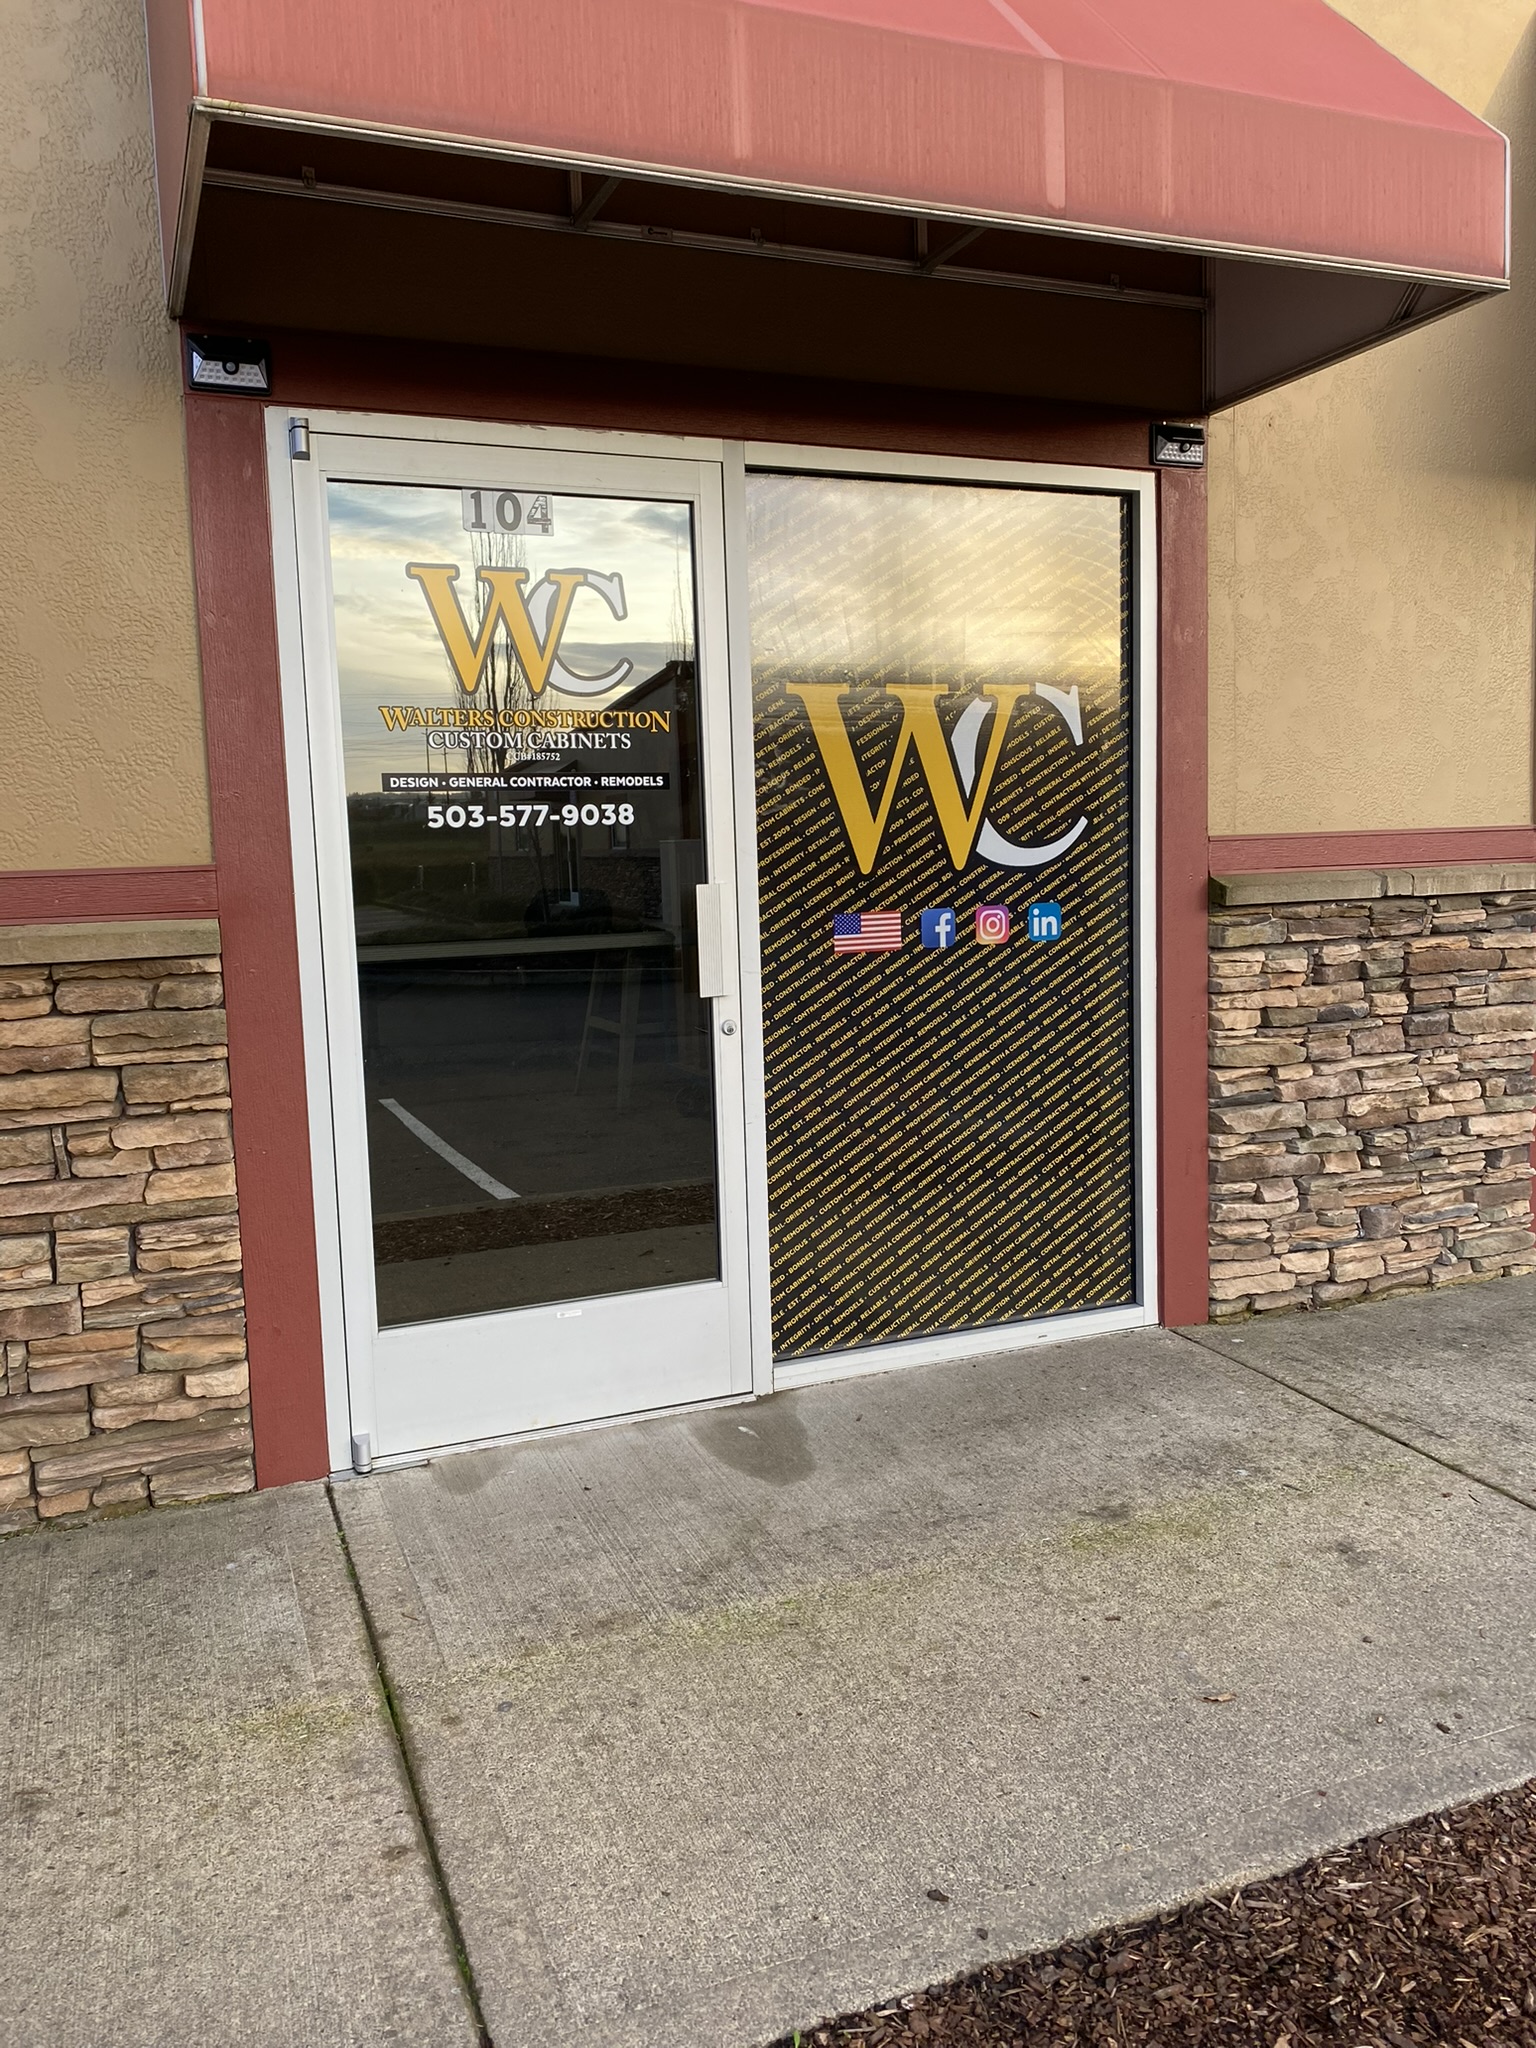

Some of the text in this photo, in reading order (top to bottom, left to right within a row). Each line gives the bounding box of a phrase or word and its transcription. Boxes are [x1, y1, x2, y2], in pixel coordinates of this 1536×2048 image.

[469, 490, 552, 534] 104
[379, 706, 671, 732] WALTERS CONSTRUCTION
[428, 731, 631, 749] CUSTOM CABINETS
[505, 752, 561, 761] CCB#185752
[766, 742, 802, 769] REMODELS
[856, 707, 881, 727] DESIGN
[389, 776, 664, 788] DESIGN GENERAL CONTRACTOR REMODELS
[427, 803, 635, 828] 503-577-9038
[772, 824, 791, 840] 2009
[792, 806, 817, 826] DESIGN
[773, 795, 805, 820] CABINETS
[783, 772, 812, 795] BONDED
[802, 724, 1061, 909] LICENSED CONSCIOUS RELIABLE
[762, 753, 1045, 956] REMODELS CUSTOM CABINETS BONDED
[771, 850, 805, 877] INTEGRITY
[775, 860, 817, 892] CONTRACTOR
[776, 749, 1099, 982] INSURED DESIGN GENERAL CONTRACTOR
[778, 753, 1069, 962] RELIABLE GENERAL CONTRACTOR CABINETS CONSTRUCTION
[805, 799, 929, 890] CONSCIOUS DESIGN
[772, 772, 1113, 1020] DESIGN GENERAL CONTRACTOR CABINETS DETAIL-ORIENTED LICENSED
[766, 1088, 797, 1114] LICENSED
[798, 1067, 826, 1090] BONDED
[827, 1045, 855, 1069] INSURED
[856, 1011, 901, 1047] PROFESSIONAL
[902, 979, 945, 1013] CONTRACTORS
[943, 967, 960, 983] WITH
[1055, 881, 1078, 900] DESIGN
[1079, 861, 1104, 883] GENERAL
[770, 821, 1115, 1075] CONTRACTOR REMODELS CUSTOM CABINETS INSURED
[795, 1108, 840, 1145] PROFESSIONAL
[842, 1074, 886, 1110] CONTRACTORS
[884, 1063, 901, 1078] WITH
[903, 1035, 938, 1063] CONSCIOUS
[939, 1013, 967, 1037] RELIABLE
[980, 990, 997, 1006] 2009
[998, 973, 1021, 993] DESIGN
[1022, 952, 1048, 975] GENERAL
[1047, 925, 1084, 956] CONTRACTOR
[1085, 902, 1116, 928] REMODELS
[778, 1173, 824, 1210] CONTRACTORS
[821, 1161, 839, 1177] WITH
[841, 1132, 877, 1162] CONSCIOUS
[878, 1109, 907, 1134] RELIABLE
[920, 1086, 937, 1102] 2009
[938, 1068, 962, 1088] DESIGN
[962, 1047, 989, 1070] GENERAL
[988, 1019, 1026, 1050] CONTRACTOR
[1027, 995, 1058, 1021] REMODELS
[1060, 975, 1084, 996] CUSTOM
[1082, 956, 1109, 979] CABINETS
[781, 977, 1123, 1243] REMODELS CUSTOM CABINETS CONSTRUCTION INTEGRITY DETAIL-ORIENTED LICENSED BONDED INSURED PROFESSIONAL
[784, 1034, 1112, 1294] CABINETS CONSTRUCTION INTEGRITY DETAIL-ORIENTED LICENSED BONDED INSURED PROFESSIONAL CONTRACTORS
[812, 1279, 865, 1323] DETAIL-ORIENTED
[865, 1254, 895, 1280] LICENSED
[896, 1233, 923, 1256] BONDED
[923, 1211, 950, 1234] INSURED
[951, 1176, 994, 1212] PROFESSIONAL
[994, 1143, 1035, 1178] CONTRACTORS
[1033, 1132, 1050, 1147] WITH
[1052, 1105, 1084, 1133] CONSCIOUS
[1085, 1083, 1111, 1107] RELIABLE
[865, 1308, 892, 1332] INSURED
[893, 1272, 936, 1309] PROFESSIONAL
[937, 1237, 979, 1273] CONTRACTORS
[977, 1226, 994, 1241] WITH
[996, 1198, 1029, 1226] CONSCIOUS
[1029, 1175, 1056, 1199] RELIABLE
[1068, 1152, 1085, 1168] 2009
[1086, 1134, 1107, 1154] DESIGN
[937, 1294, 971, 1324] CONSCIOUS
[971, 1271, 999, 1295] RELIABLE
[1011, 1247, 1028, 1263] 2009
[1029, 1228, 1051, 1248] DESIGN
[1052, 1207, 1077, 1230] GENERAL
[1076, 1178, 1112, 1210] CONTRACTOR
[1013, 1210, 1131, 1310] CONTRACTOR REMODELS CUSTOM CABINETS
[1085, 1262, 1126, 1299] CONSTRUCTION
